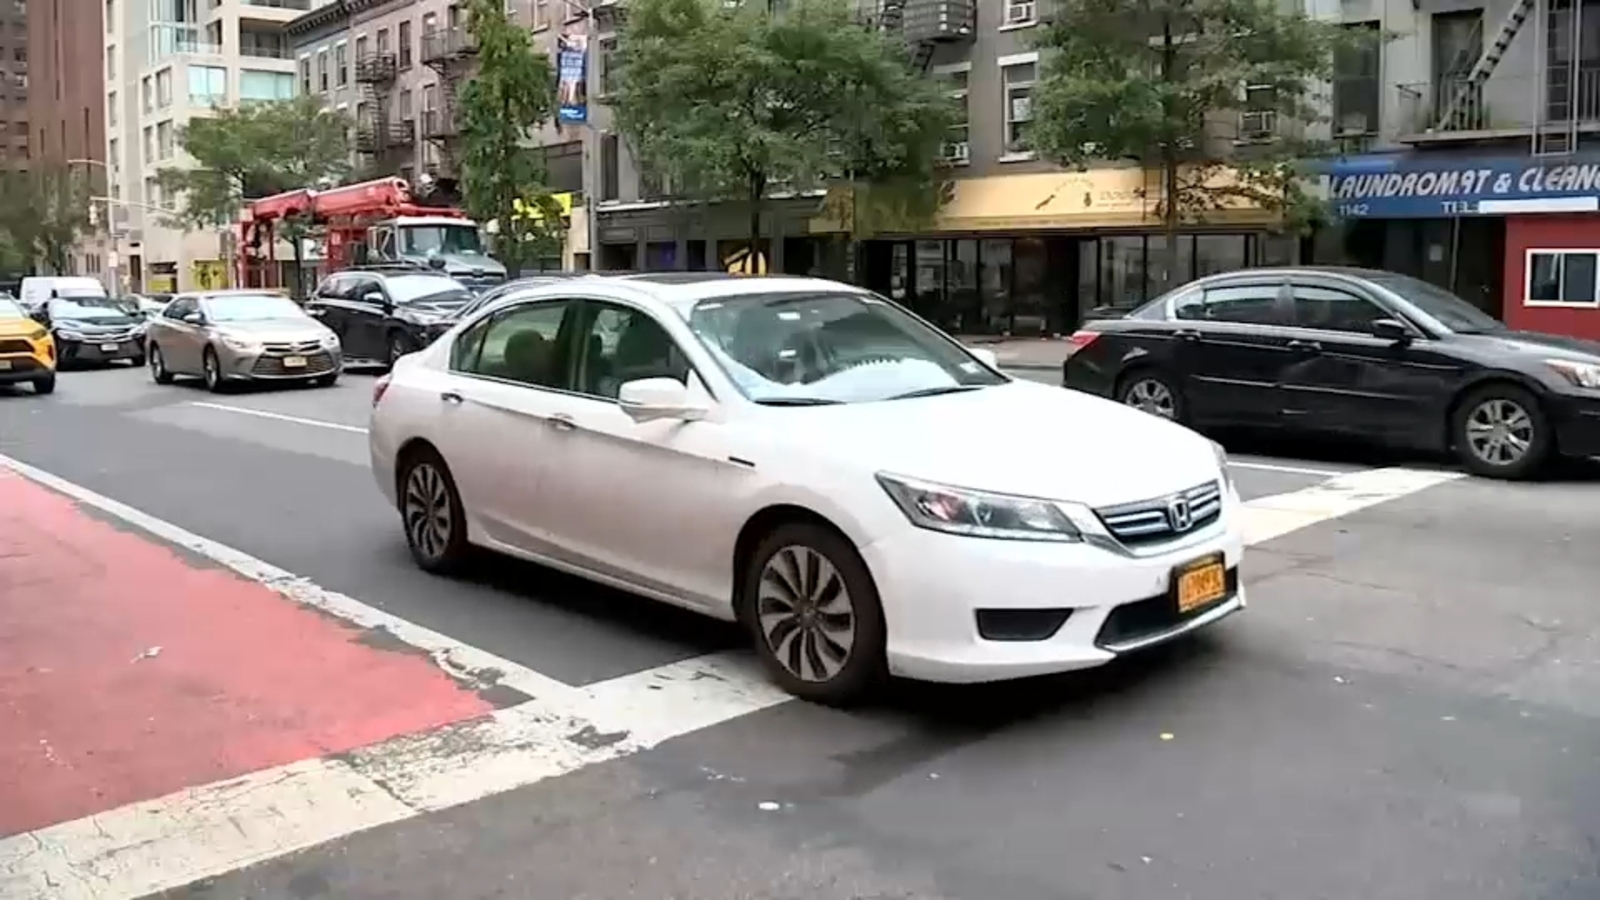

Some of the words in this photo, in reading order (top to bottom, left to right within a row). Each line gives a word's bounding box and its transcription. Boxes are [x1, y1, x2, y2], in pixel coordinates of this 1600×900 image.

[1330, 169, 1492, 199] LAUNDROMAT
[1493, 172, 1512, 193] &
[1338, 203, 1369, 216] 1142
